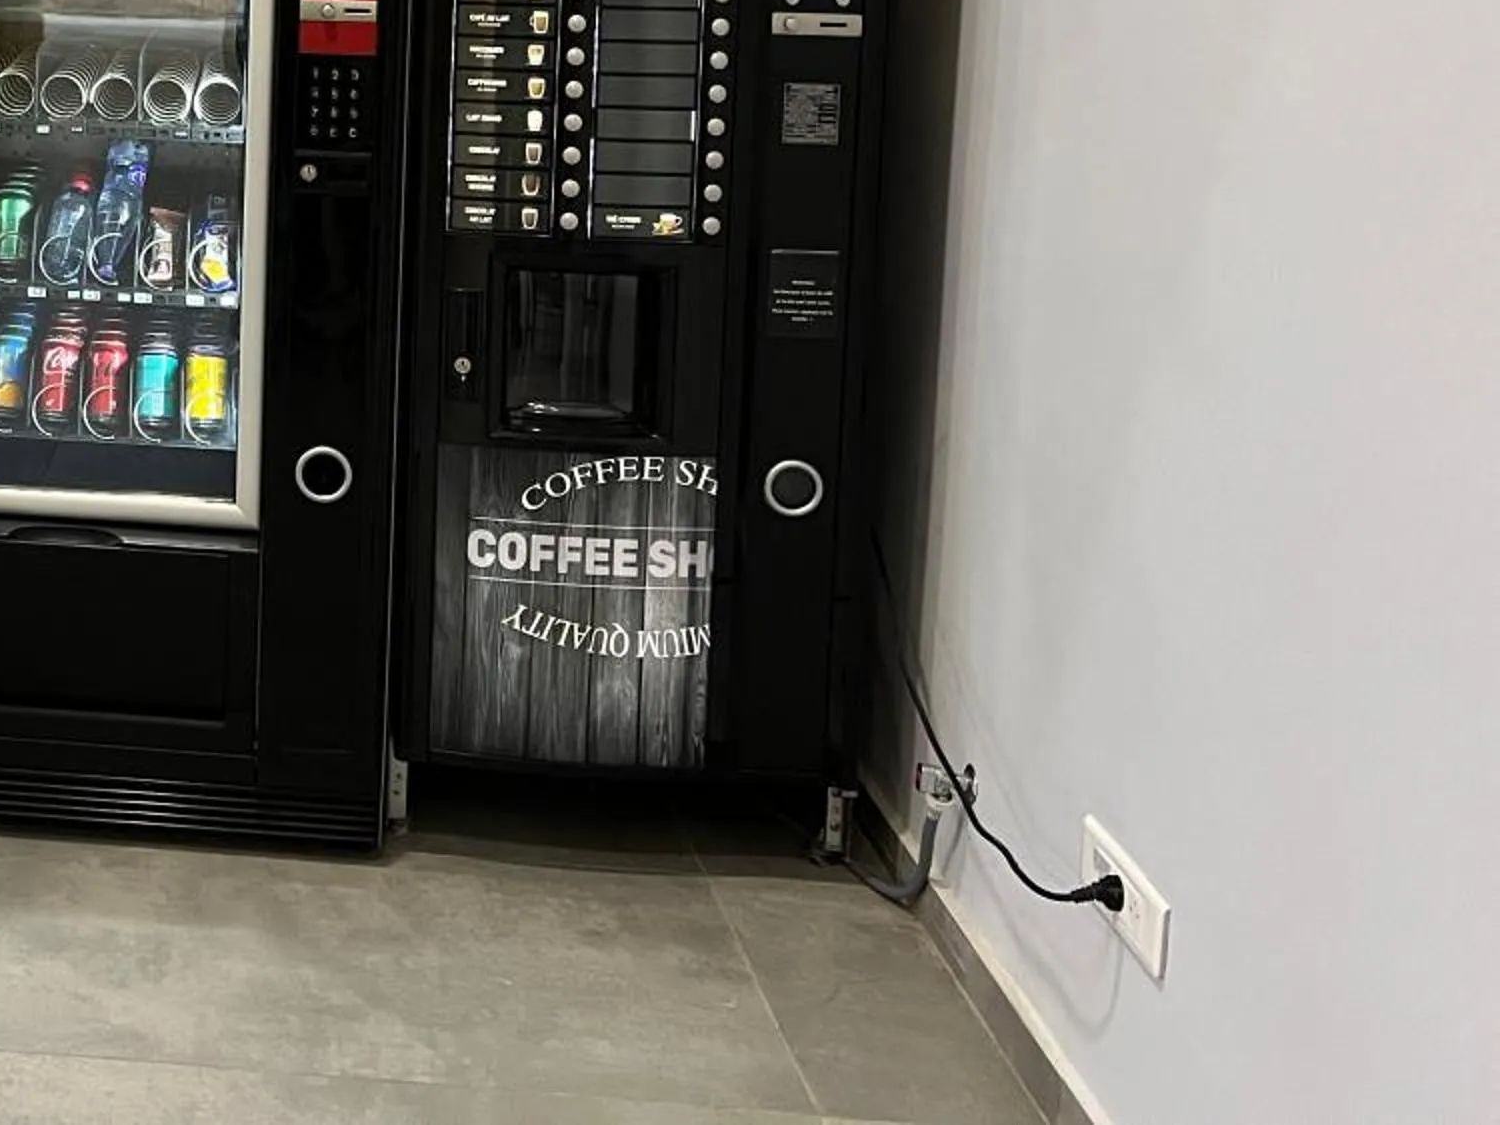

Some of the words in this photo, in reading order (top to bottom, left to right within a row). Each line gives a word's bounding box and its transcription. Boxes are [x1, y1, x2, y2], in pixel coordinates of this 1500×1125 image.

[521, 456, 665, 511] COFFEE
[467, 529, 639, 577] COFFEE
[647, 539, 714, 578] SH
[502, 603, 630, 658] QUALITY
